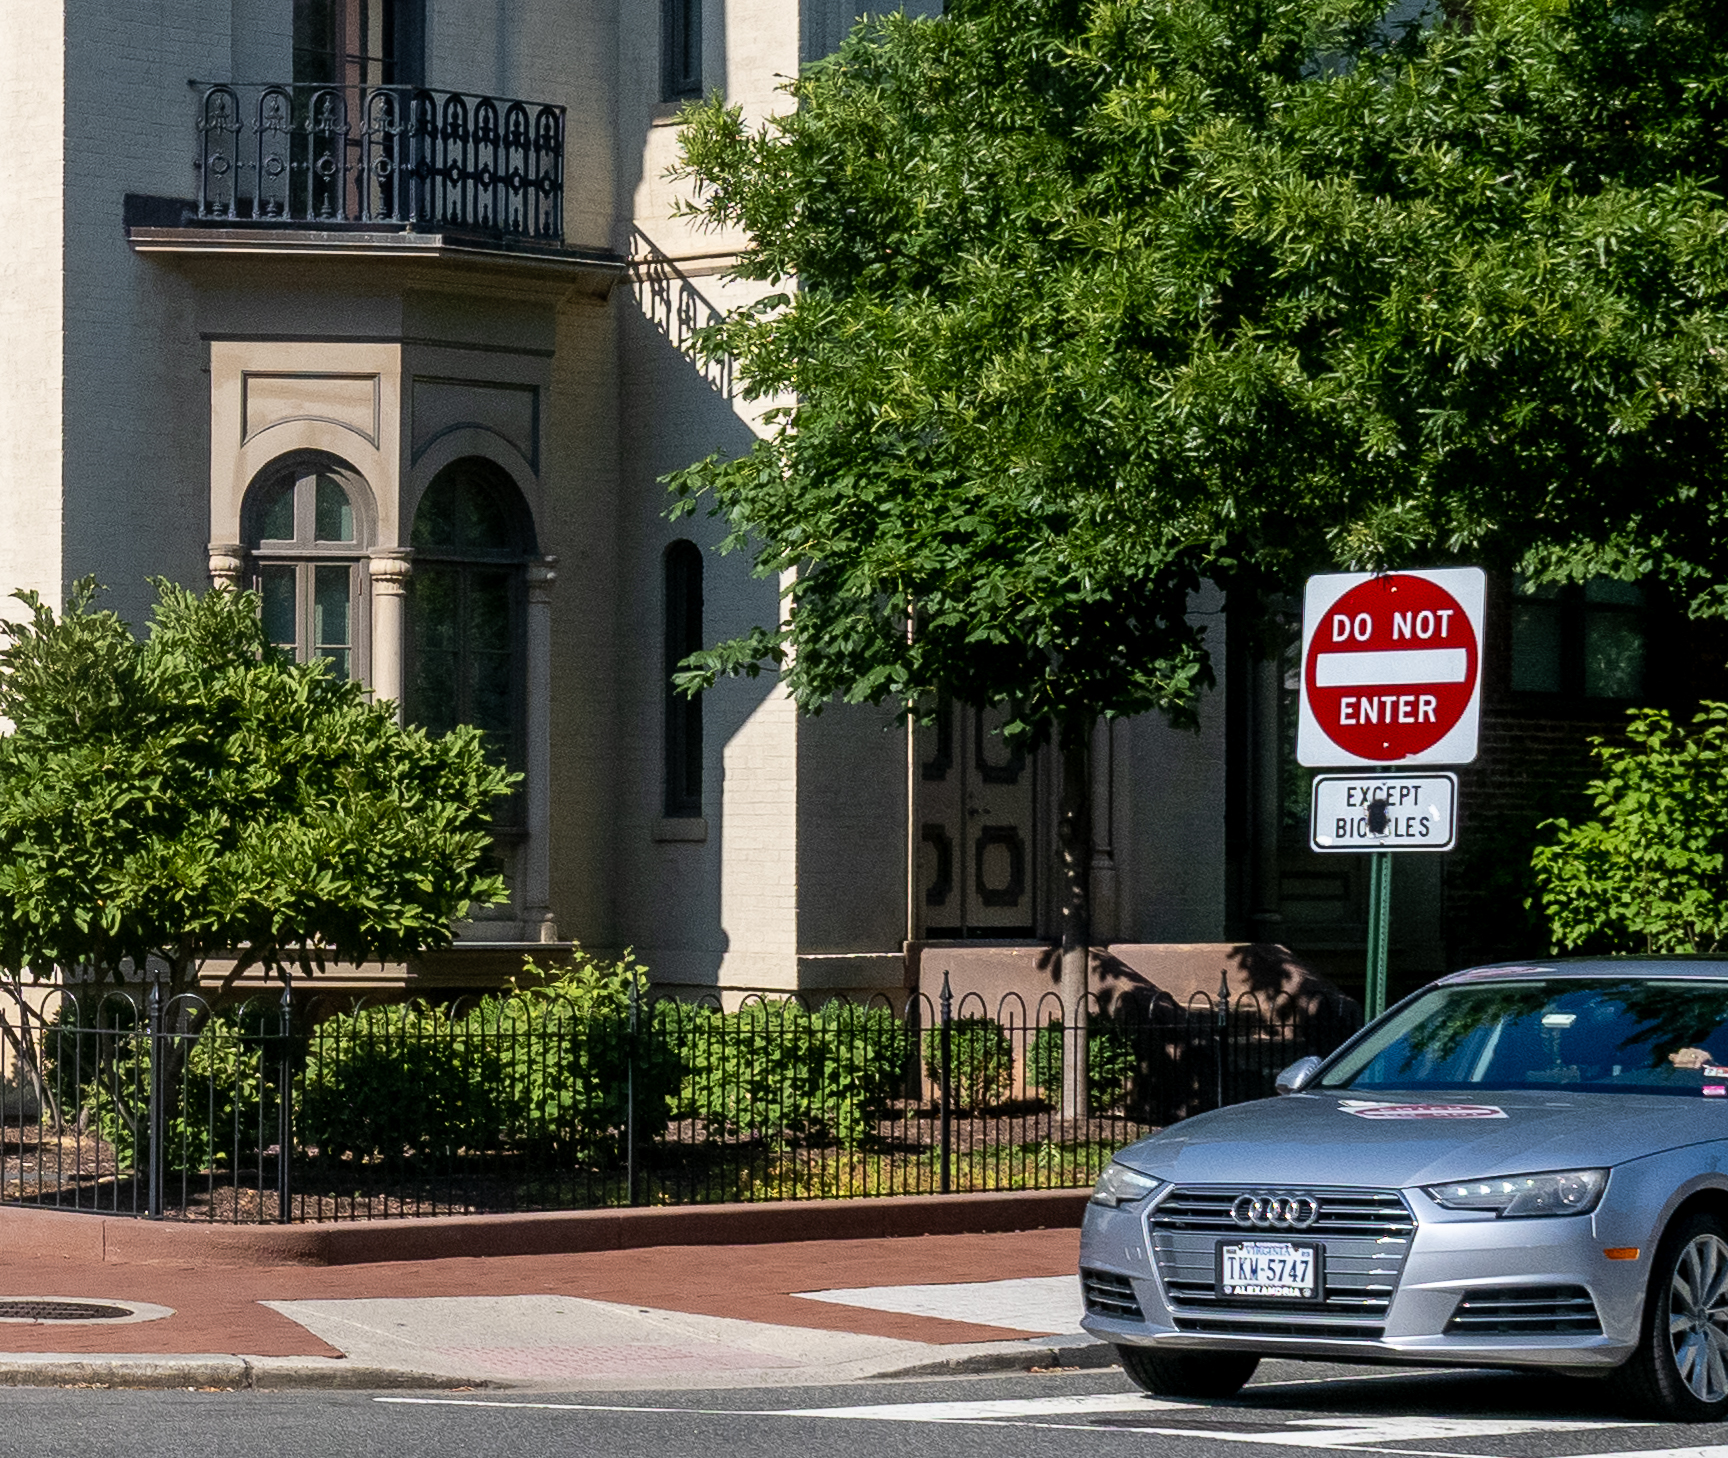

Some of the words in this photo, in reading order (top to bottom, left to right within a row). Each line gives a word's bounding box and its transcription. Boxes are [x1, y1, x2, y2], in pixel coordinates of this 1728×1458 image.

[1332, 612, 1373, 642] DO
[1392, 609, 1454, 640] NOT
[1339, 694, 1437, 725] ENTER
[1346, 785, 1422, 807] EXCEPT
[1335, 816, 1430, 839] BICLES
[1245, 1245, 1292, 1257] VIRGINIA
[1227, 1256, 1310, 1283] TKM-5747
[1233, 1285, 1302, 1297] ALEXANDRIA
